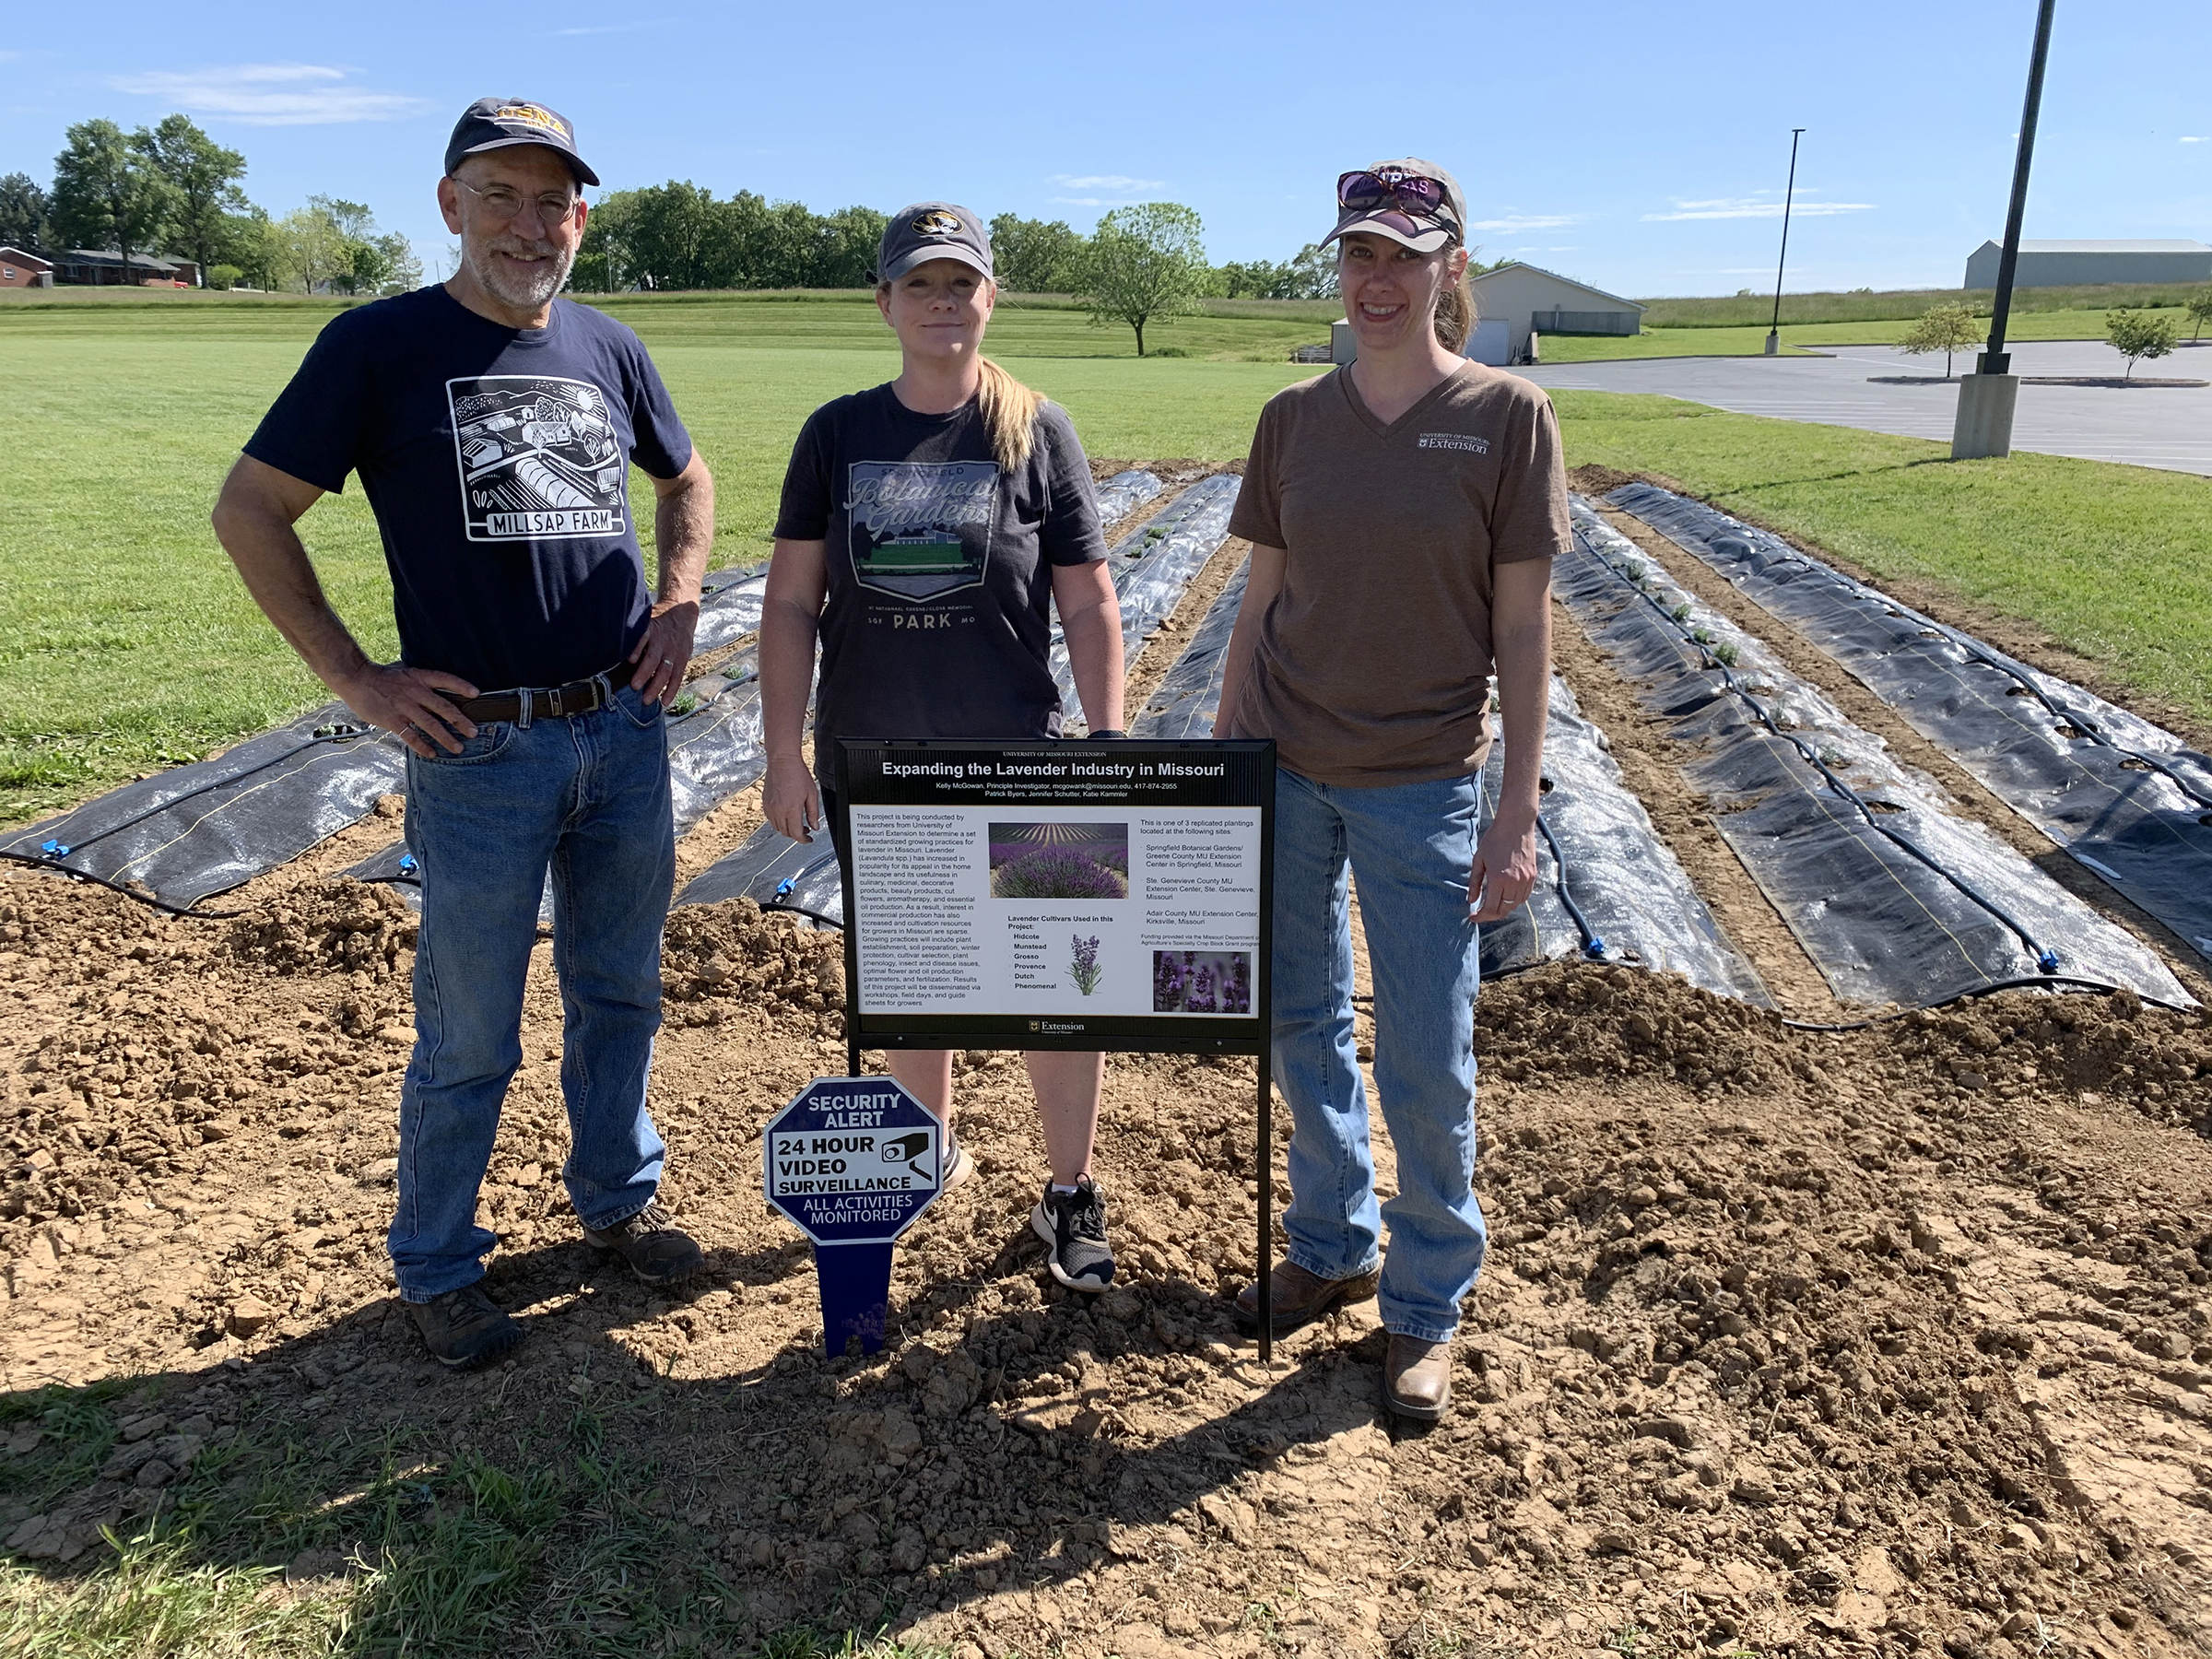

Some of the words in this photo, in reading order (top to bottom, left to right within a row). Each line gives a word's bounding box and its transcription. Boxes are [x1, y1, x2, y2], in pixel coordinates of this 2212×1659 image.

[497, 108, 566, 135] USNA
[1429, 438, 1487, 454] Extension
[881, 467, 964, 477] SPRINGFIELD
[843, 473, 1000, 510] Botanical
[494, 513, 564, 533] MILLSAP
[573, 512, 609, 530] FARM
[866, 498, 989, 541] Gardens
[893, 613, 951, 629] PARK
[883, 762, 963, 779] Expanding
[967, 763, 992, 775] the
[997, 763, 1067, 775] Lavender
[1072, 763, 1135, 779] Industry
[1140, 763, 1153, 776] in
[1159, 763, 1224, 776] Missouri
[872, 814, 893, 822] project
[902, 814, 920, 822] being
[912, 822, 944, 831] University
[1191, 820, 1222, 828] replicated
[1224, 820, 1254, 828] plantings
[1041, 1021, 1084, 1030] Extension
[808, 1093, 901, 1111] SECURITY
[824, 1111, 884, 1128] ALERT
[778, 1139, 806, 1155] 24
[812, 1136, 874, 1154] HOUR
[778, 1159, 847, 1176] VIDEO
[779, 1177, 911, 1194] SURVEILLANCE
[804, 1199, 830, 1211] ALL
[834, 1195, 913, 1209] ACTIVITIES
[811, 1209, 901, 1224] MONITORED
